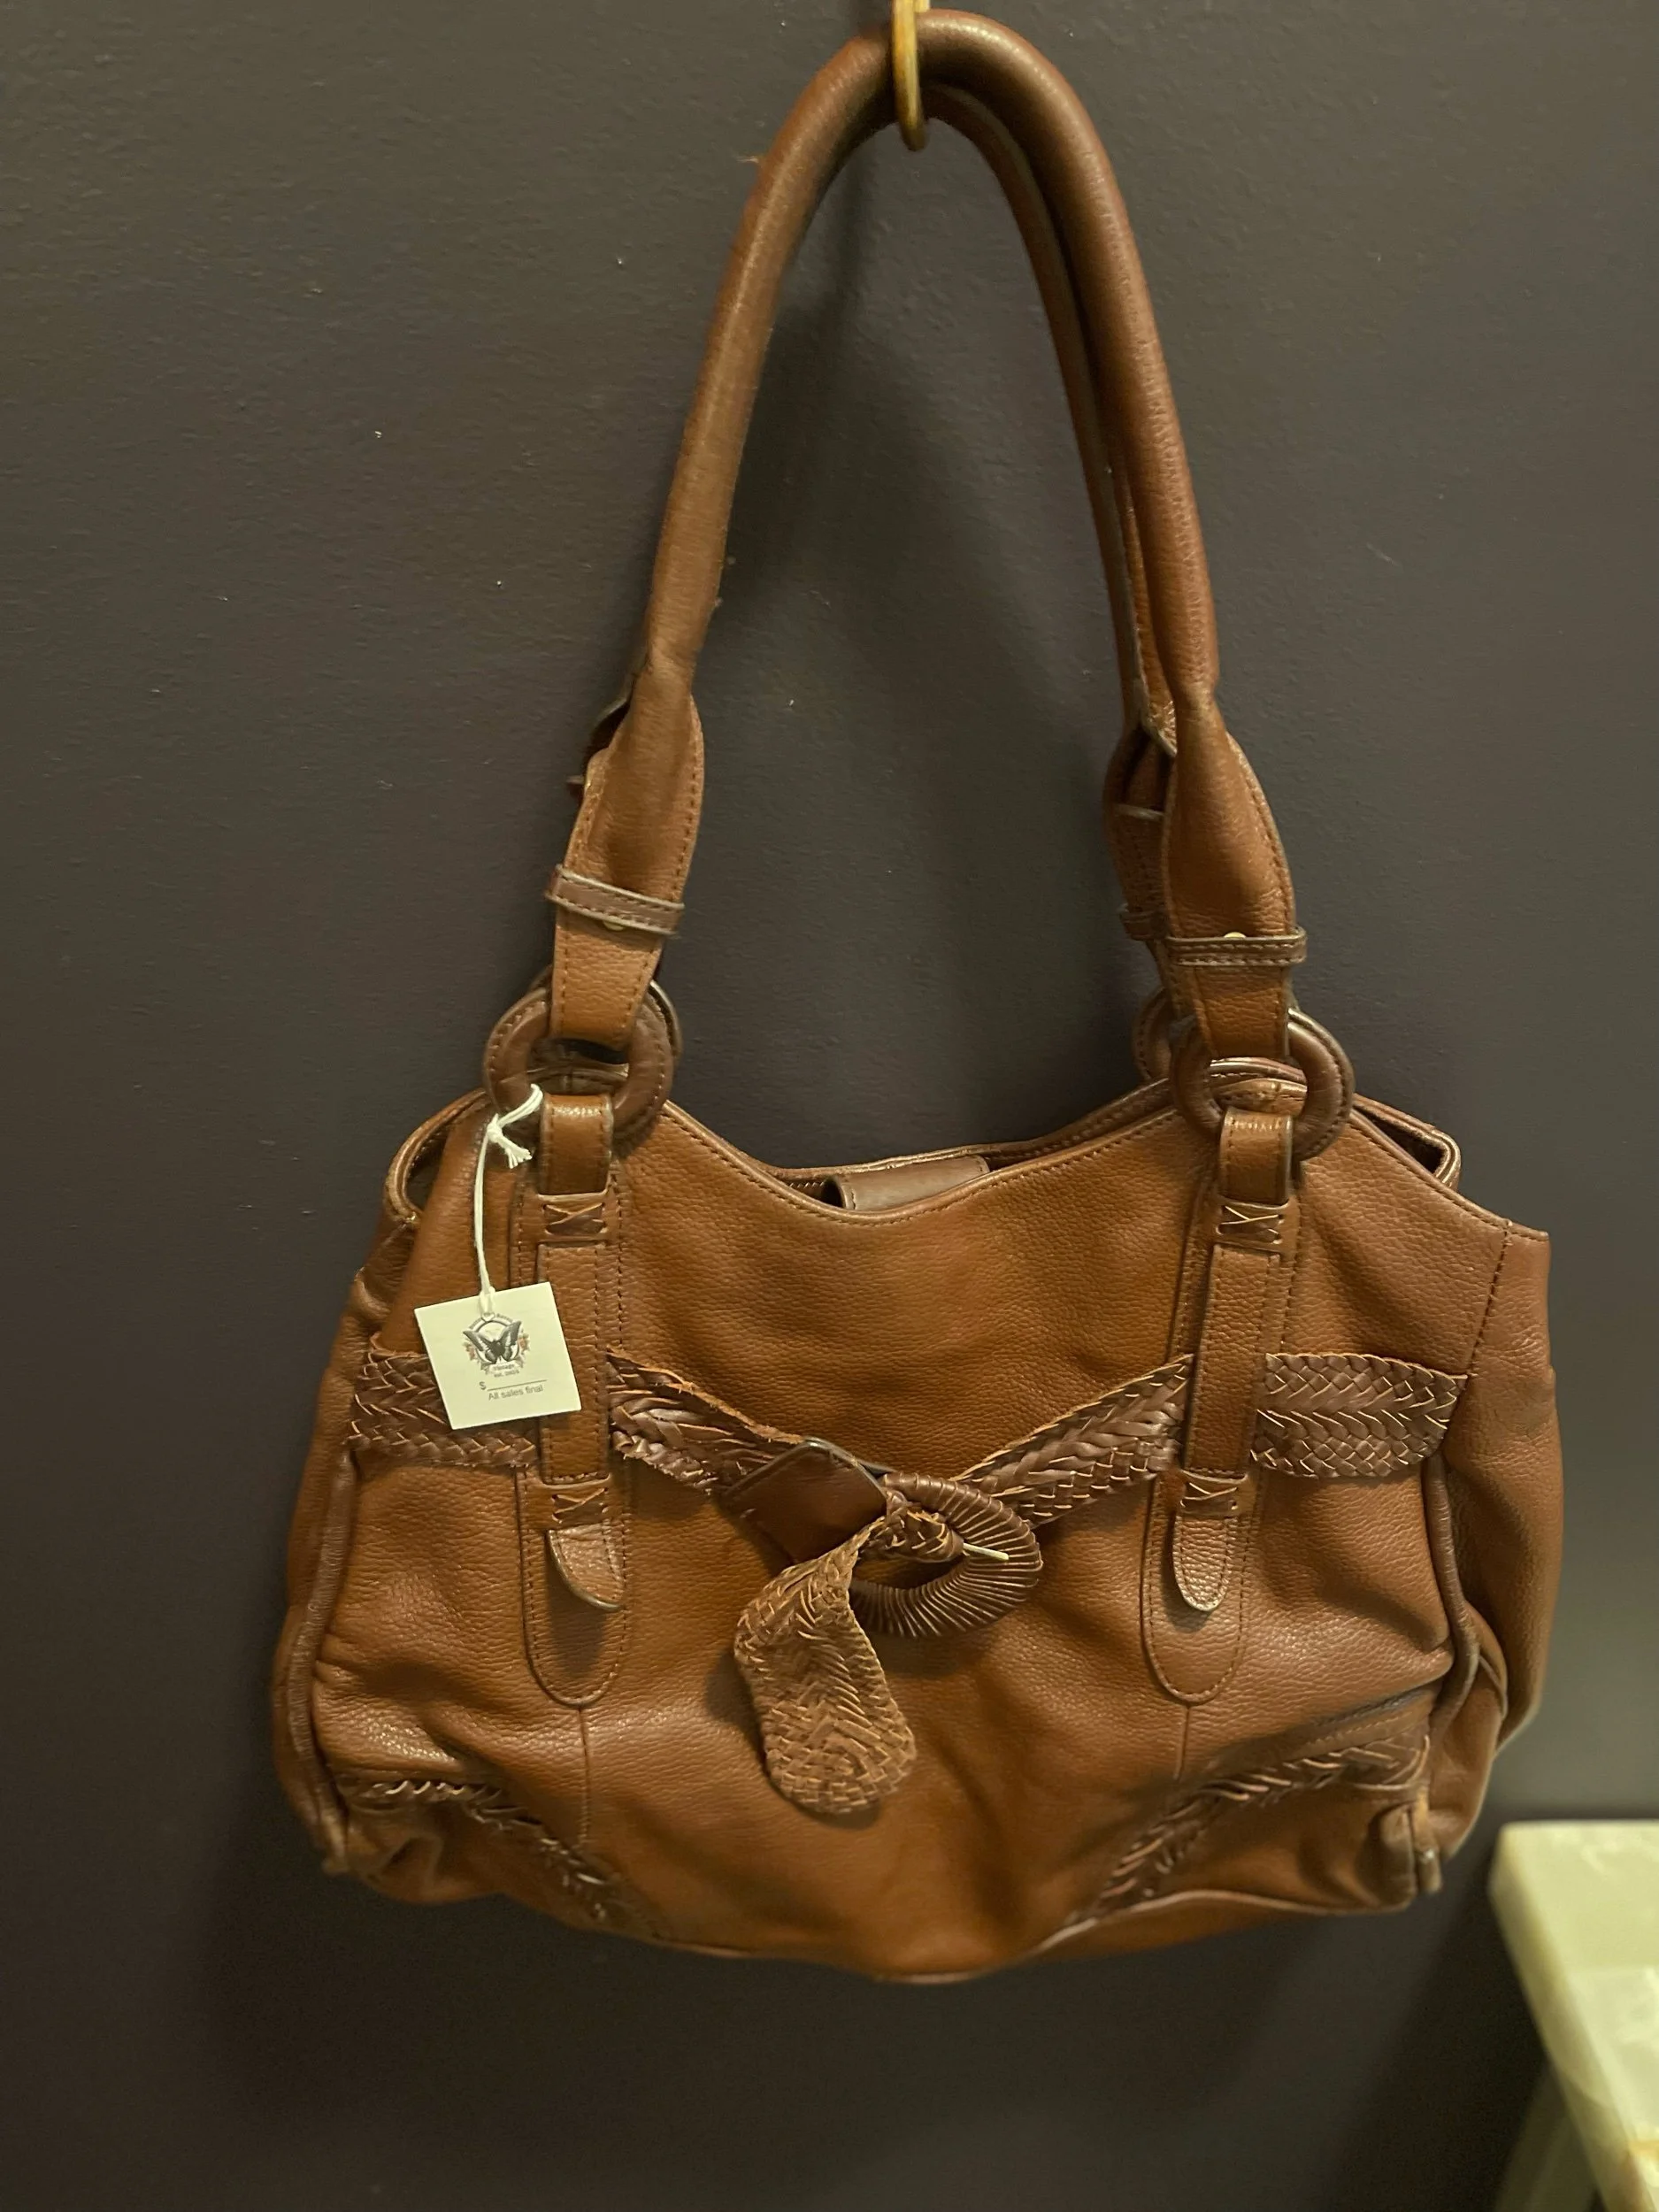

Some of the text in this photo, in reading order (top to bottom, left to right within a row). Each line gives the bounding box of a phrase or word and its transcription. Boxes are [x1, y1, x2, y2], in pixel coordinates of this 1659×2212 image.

[488, 1385, 543, 1401] All sales final
